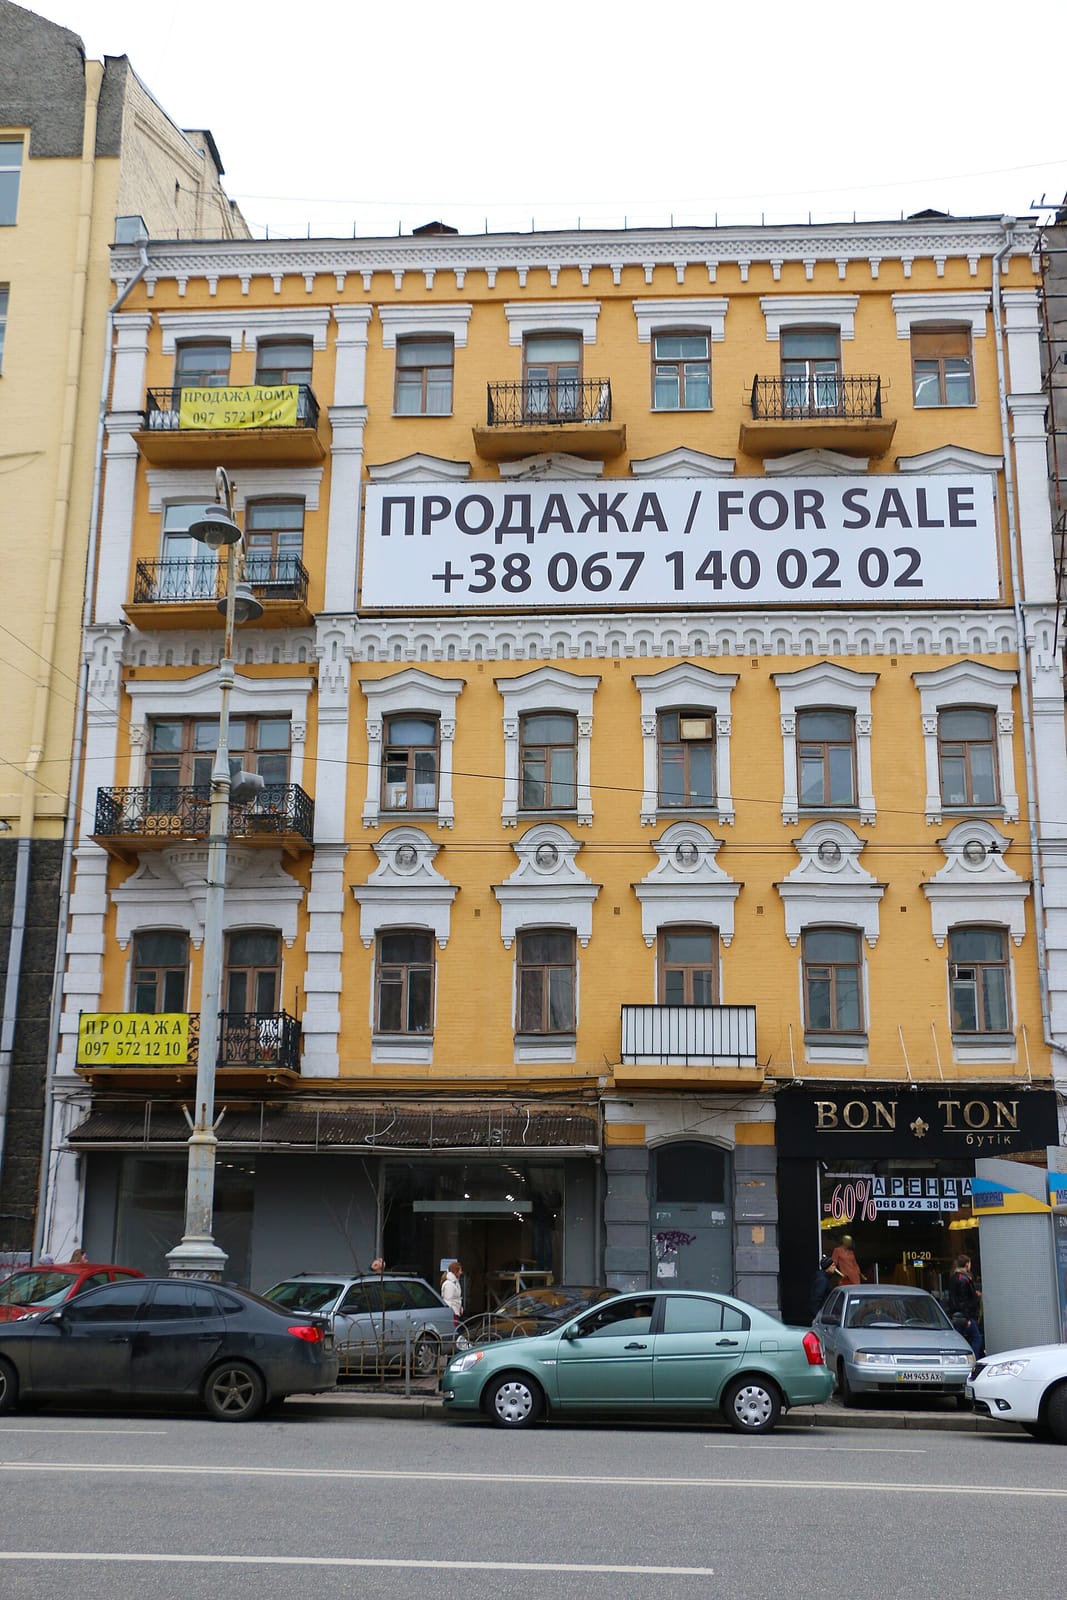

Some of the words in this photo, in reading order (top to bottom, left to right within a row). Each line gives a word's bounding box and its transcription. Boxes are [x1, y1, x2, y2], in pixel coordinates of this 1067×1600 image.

[184, 390, 251, 404] ПРОДАЖА
[254, 389, 294, 403] ДОМА
[192, 411, 215, 424] 097
[223, 410, 246, 424] 572
[251, 410, 264, 423] 12
[268, 409, 282, 422] 10
[381, 492, 669, 545] ПРОДАЖА
[684, 490, 702, 534] /
[718, 489, 827, 531] FOR
[842, 486, 977, 529] SALE
[431, 552, 532, 594] +38
[547, 551, 645, 593] 067
[664, 549, 761, 591] 140
[776, 547, 842, 590] 02
[857, 546, 924, 588] 02
[85, 1020, 182, 1038] ПРОДАЖА
[84, 1041, 109, 1056] 097
[116, 1041, 140, 1056] 572
[145, 1041, 161, 1056] 12
[165, 1041, 181, 1056] 10
[813, 1100, 898, 1129] BON
[937, 1100, 1020, 1129] TON
[966, 1133, 1012, 1148] бутік
[873, 1178, 973, 1195] АРЕНДА
[824, 1180, 877, 1221] -60%
[926, 1200, 939, 1209] 38
[943, 1200, 956, 1209] 85
